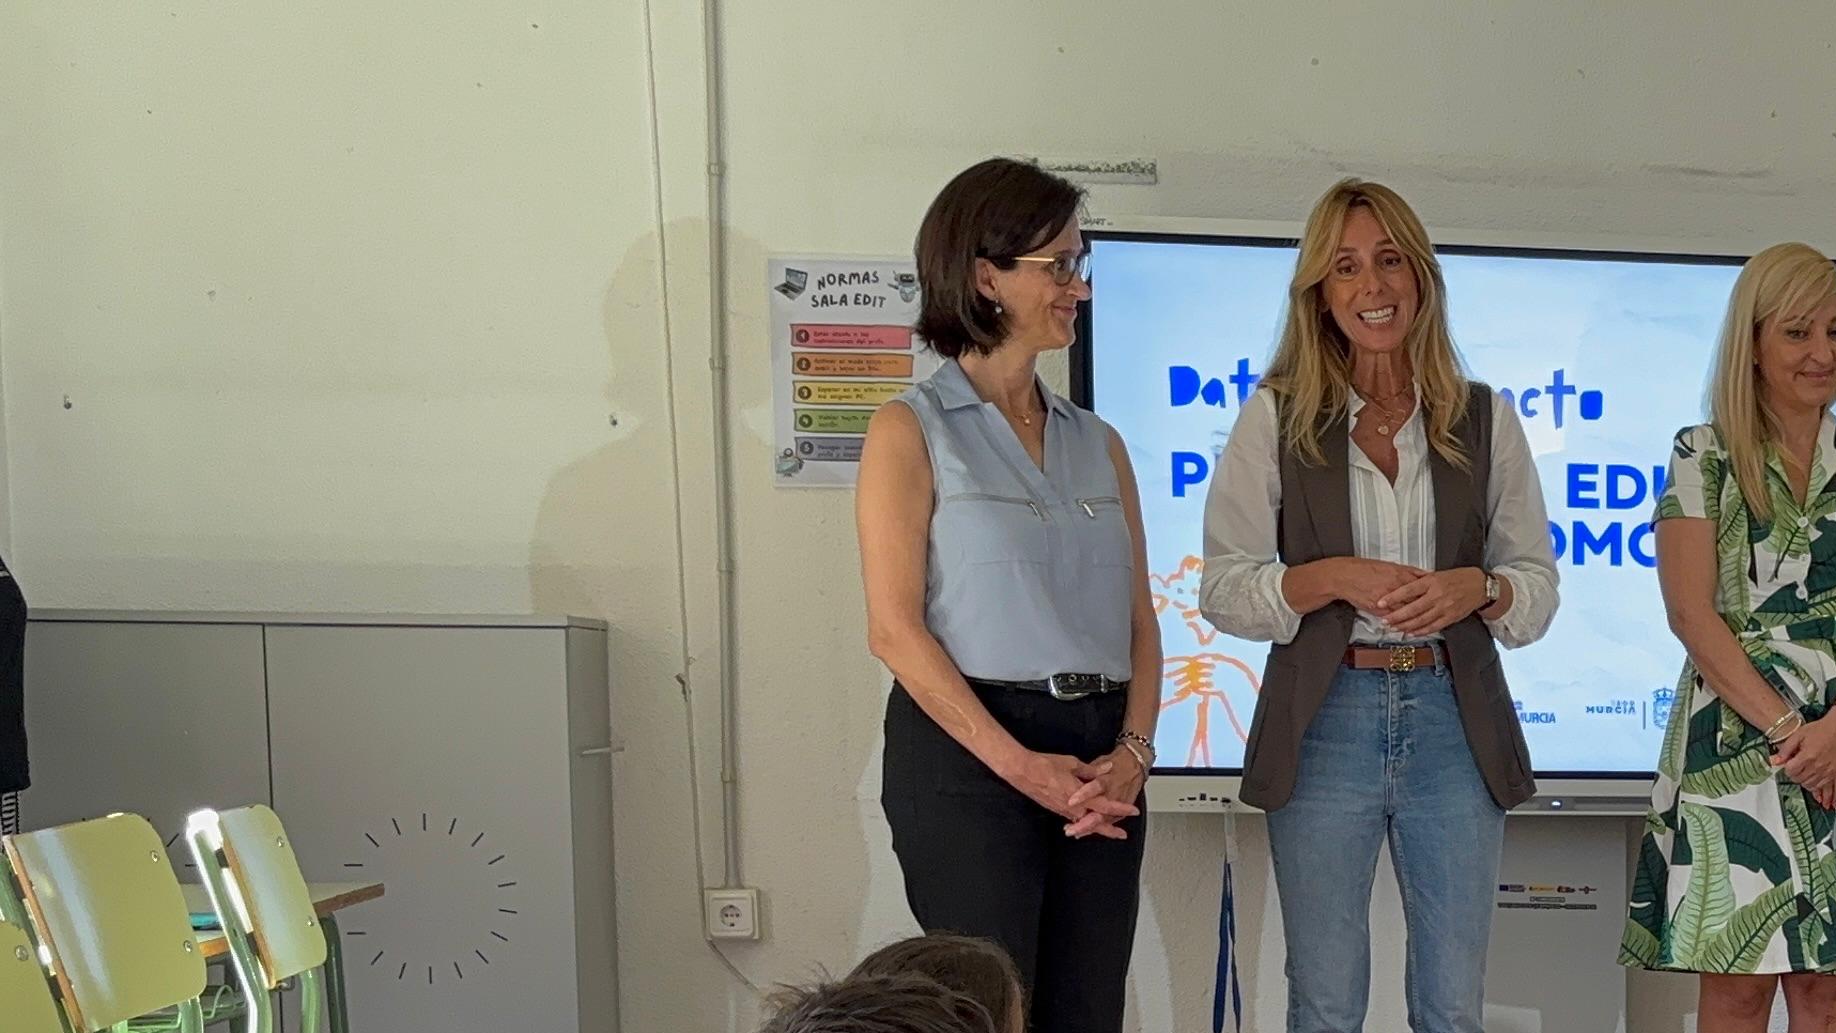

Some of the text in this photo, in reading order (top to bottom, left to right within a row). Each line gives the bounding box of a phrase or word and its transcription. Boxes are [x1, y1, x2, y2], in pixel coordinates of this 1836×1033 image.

[818, 270, 880, 290] NORMAS
[811, 293, 886, 308] SALA EDIT
[1169, 358, 1262, 408] Dat
[1171, 451, 1209, 498] P
[1586, 704, 1636, 715] MURCIA
